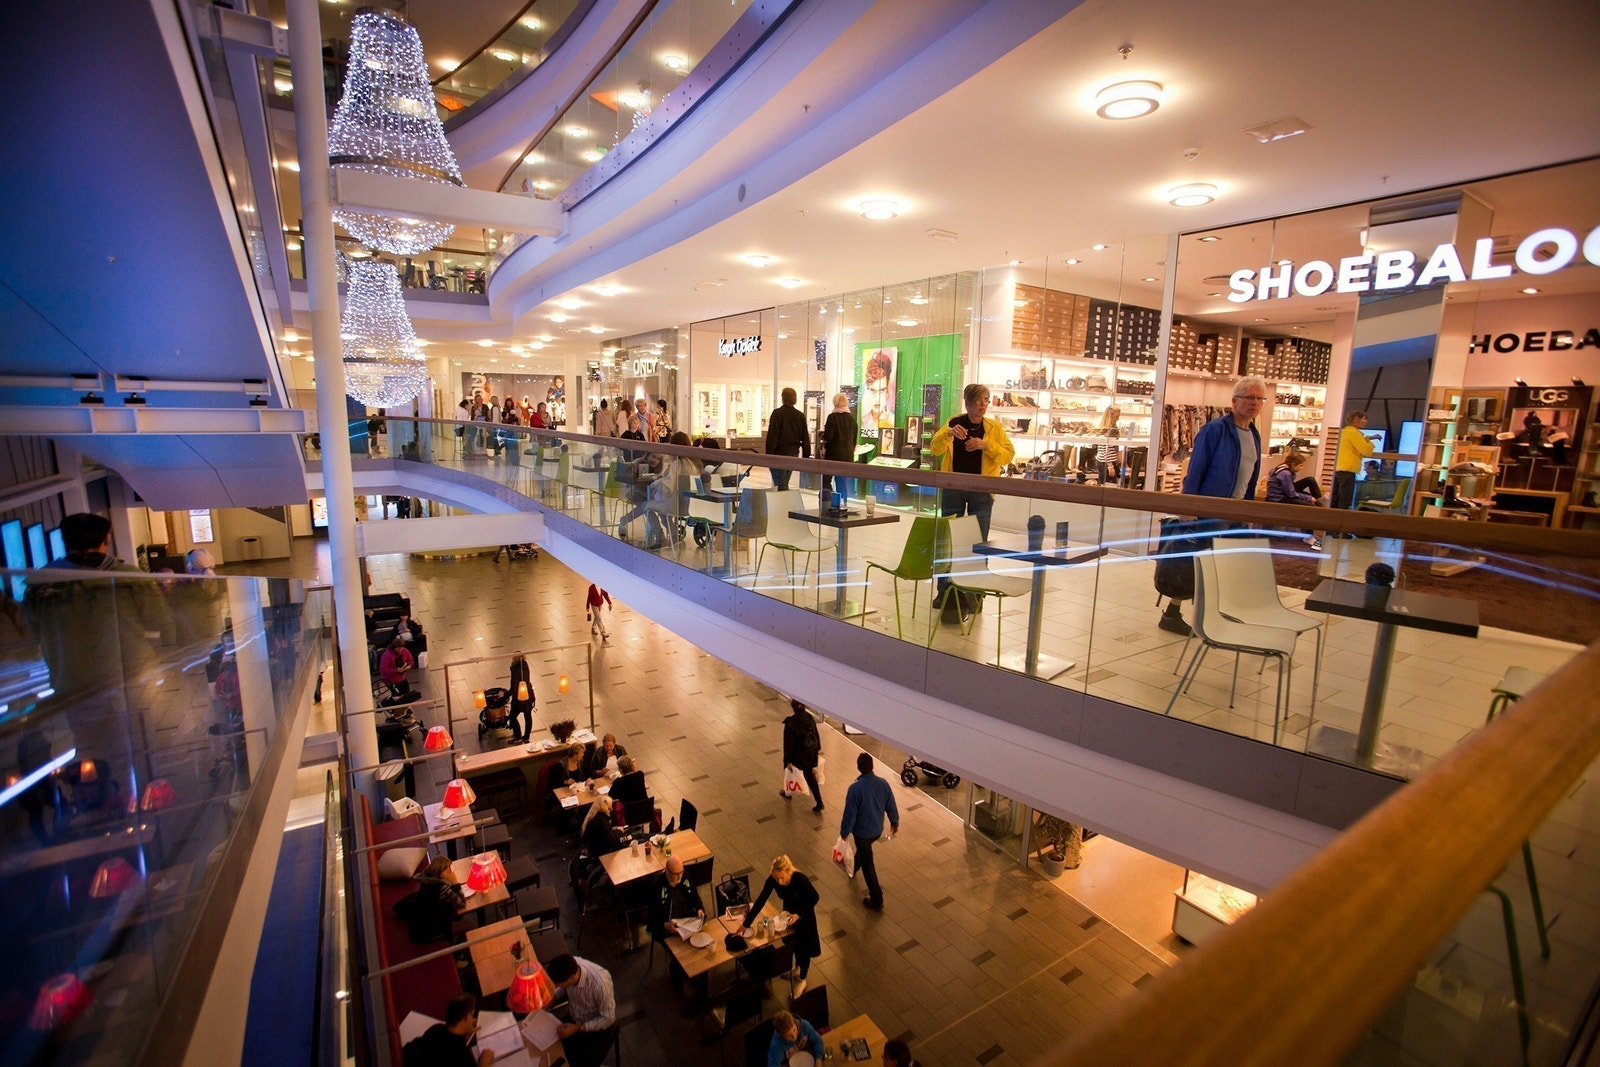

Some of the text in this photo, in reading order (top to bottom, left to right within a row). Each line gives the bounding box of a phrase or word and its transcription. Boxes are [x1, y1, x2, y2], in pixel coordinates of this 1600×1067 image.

[1227, 226, 1600, 303] SHOEBALO
[633, 357, 659, 376] ONLY
[1005, 378, 1087, 391] SHOEBALOO
[1529, 389, 1569, 404] UGG
[860, 428, 875, 438] FACE
[786, 780, 803, 792] ICA
[832, 848, 845, 866] IC
